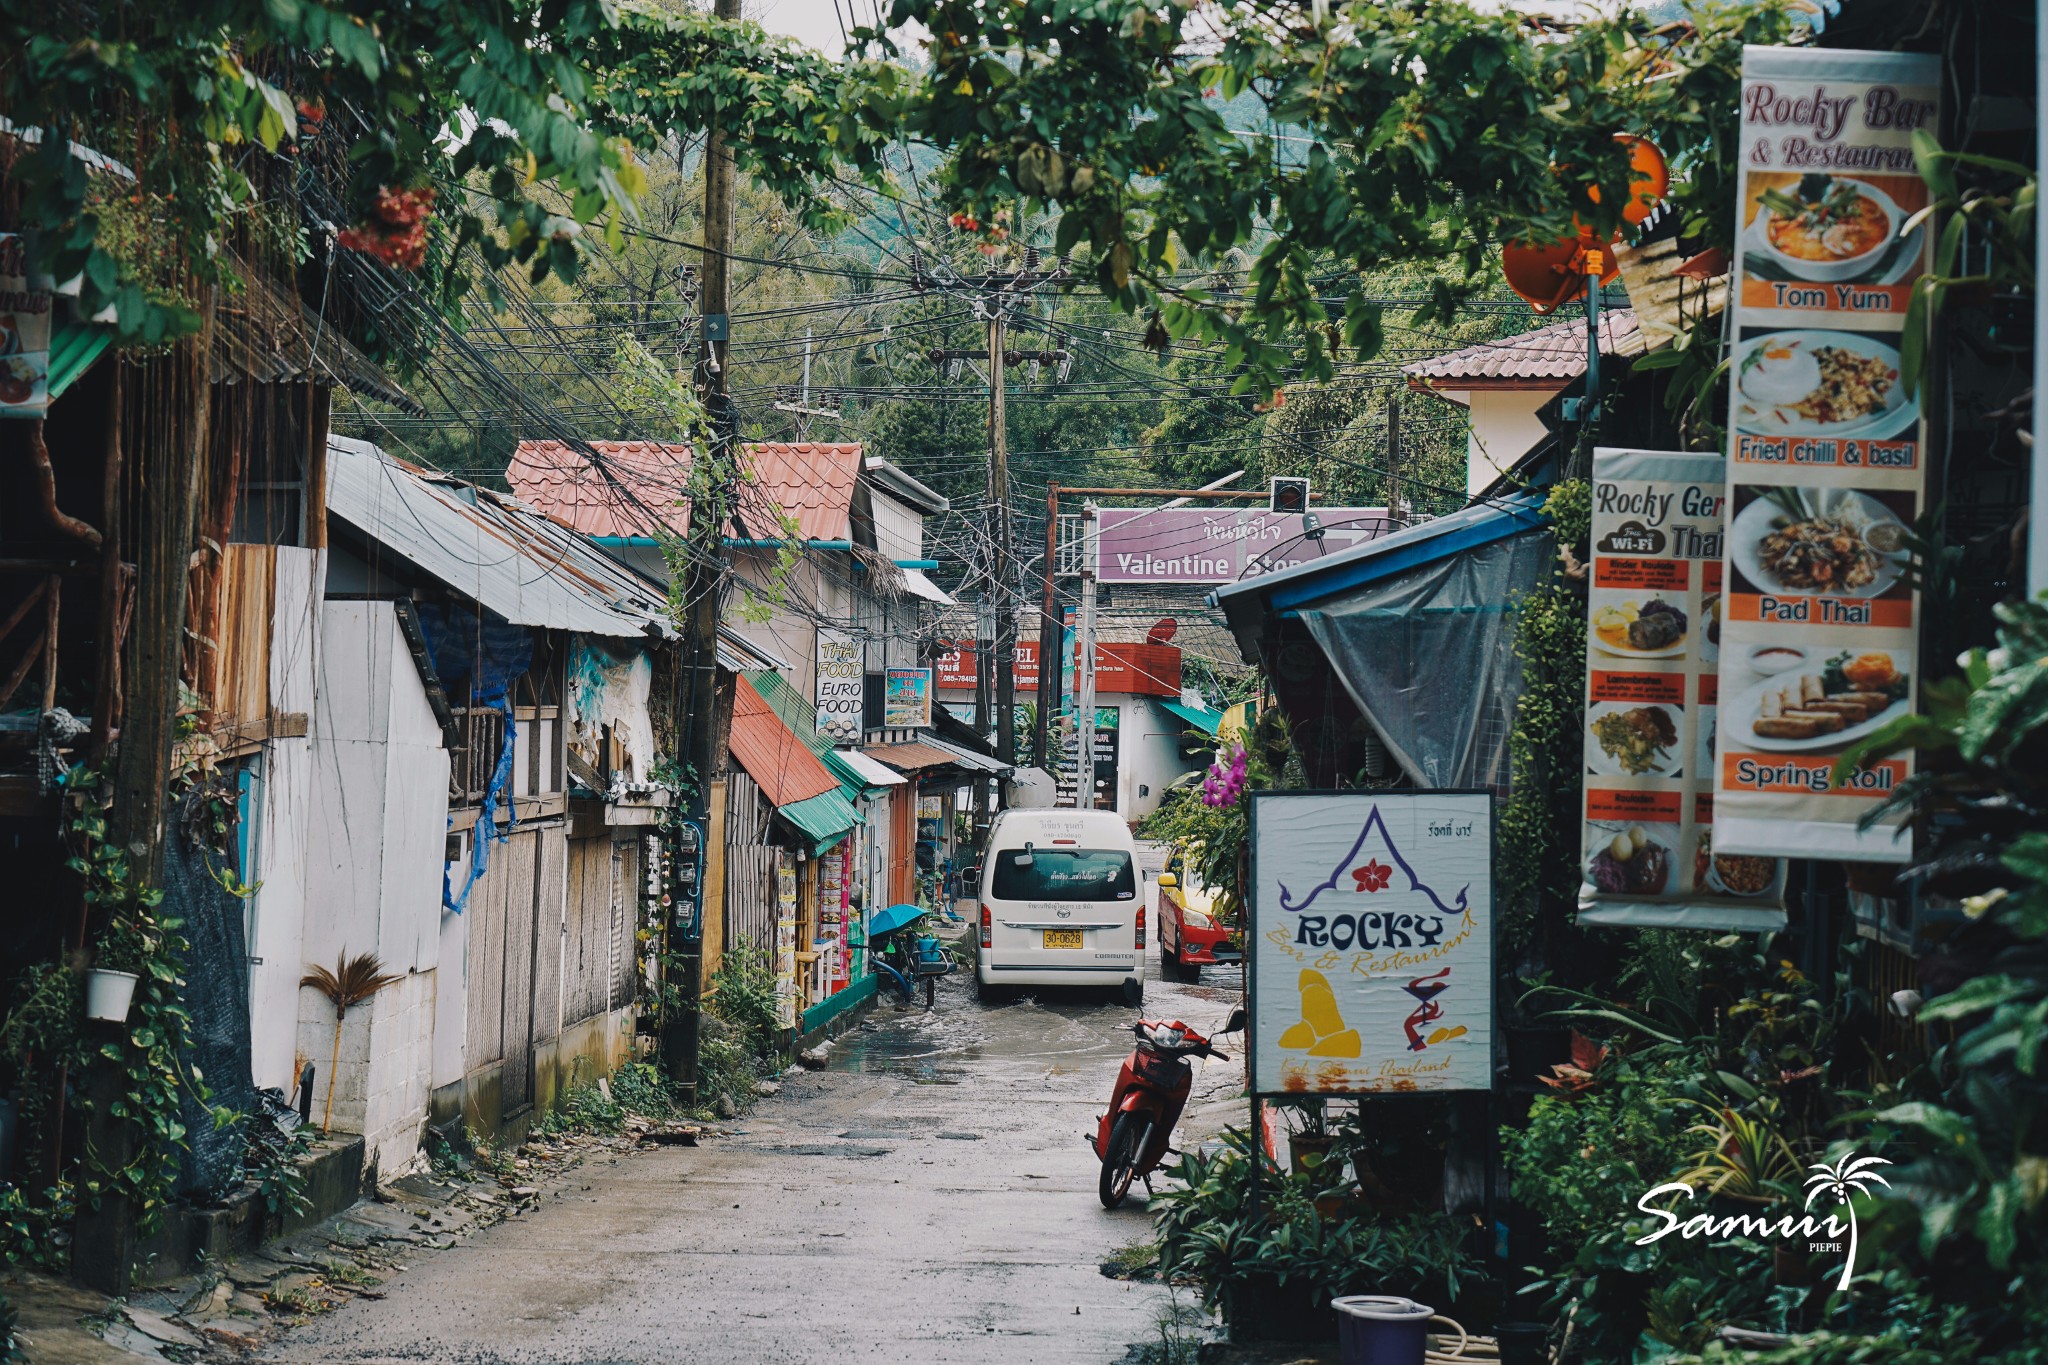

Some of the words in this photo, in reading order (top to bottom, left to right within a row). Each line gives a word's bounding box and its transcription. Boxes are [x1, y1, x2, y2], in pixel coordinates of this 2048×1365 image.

[1743, 82, 1857, 141] Rocky
[1863, 85, 1936, 130] Bar
[1751, 136, 1771, 166] &
[1781, 134, 1918, 171] Restauran
[1772, 282, 1827, 308] Tom
[1834, 284, 1892, 311] Yum
[1738, 437, 1789, 462] Fried
[1793, 440, 1838, 465] chilli
[1843, 441, 1862, 466] &
[1868, 441, 1917, 468] basil
[1597, 483, 1675, 527] Rocky
[1682, 485, 1726, 517] Ger
[1611, 537, 1654, 552] Wi-Fi
[1116, 554, 1229, 575] Valentine
[1760, 595, 1811, 621] Pad
[1817, 599, 1872, 625] Thai
[821, 641, 860, 658] THAI
[817, 661, 864, 679] FOOD
[821, 682, 862, 697] EURO
[817, 699, 864, 714] FOOD
[1737, 759, 1830, 792] Spring
[1046, 933, 1081, 944] 30-0628
[1266, 922, 1306, 963] Bar
[1314, 950, 1341, 970] &
[1351, 907, 1478, 977] Restaurant
[1294, 912, 1444, 951] ROCKY
[1378, 1055, 1453, 1076] Thailand
